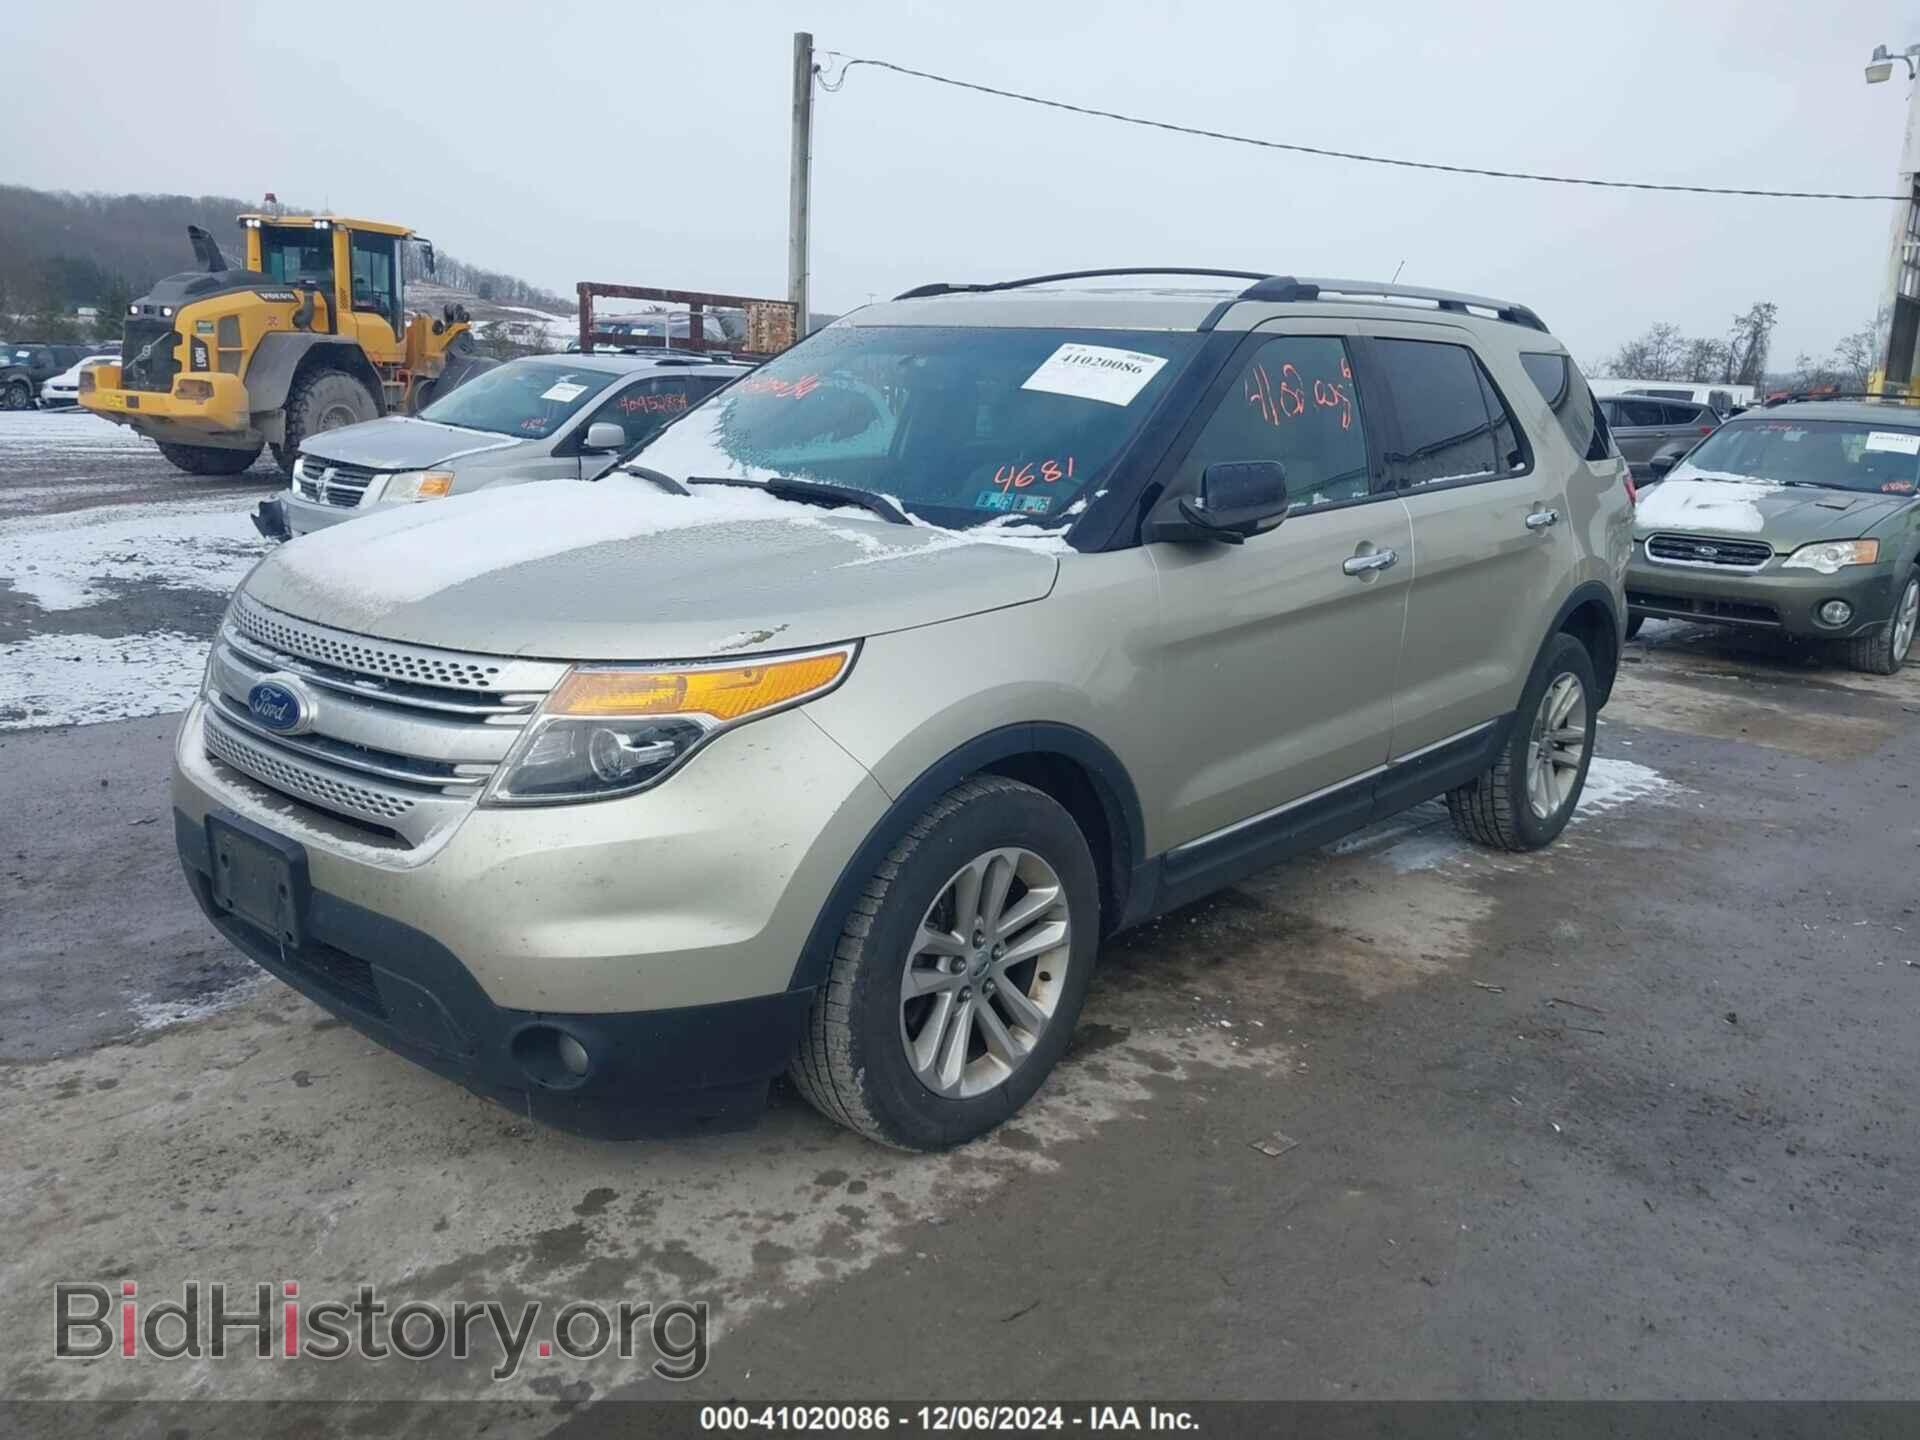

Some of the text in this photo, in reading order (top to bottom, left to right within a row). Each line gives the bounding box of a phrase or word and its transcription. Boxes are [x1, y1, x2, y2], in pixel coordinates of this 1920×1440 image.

[1062, 354, 1143, 375] 41020086
[994, 457, 1073, 494] 4681
[254, 687, 289, 721] Ford
